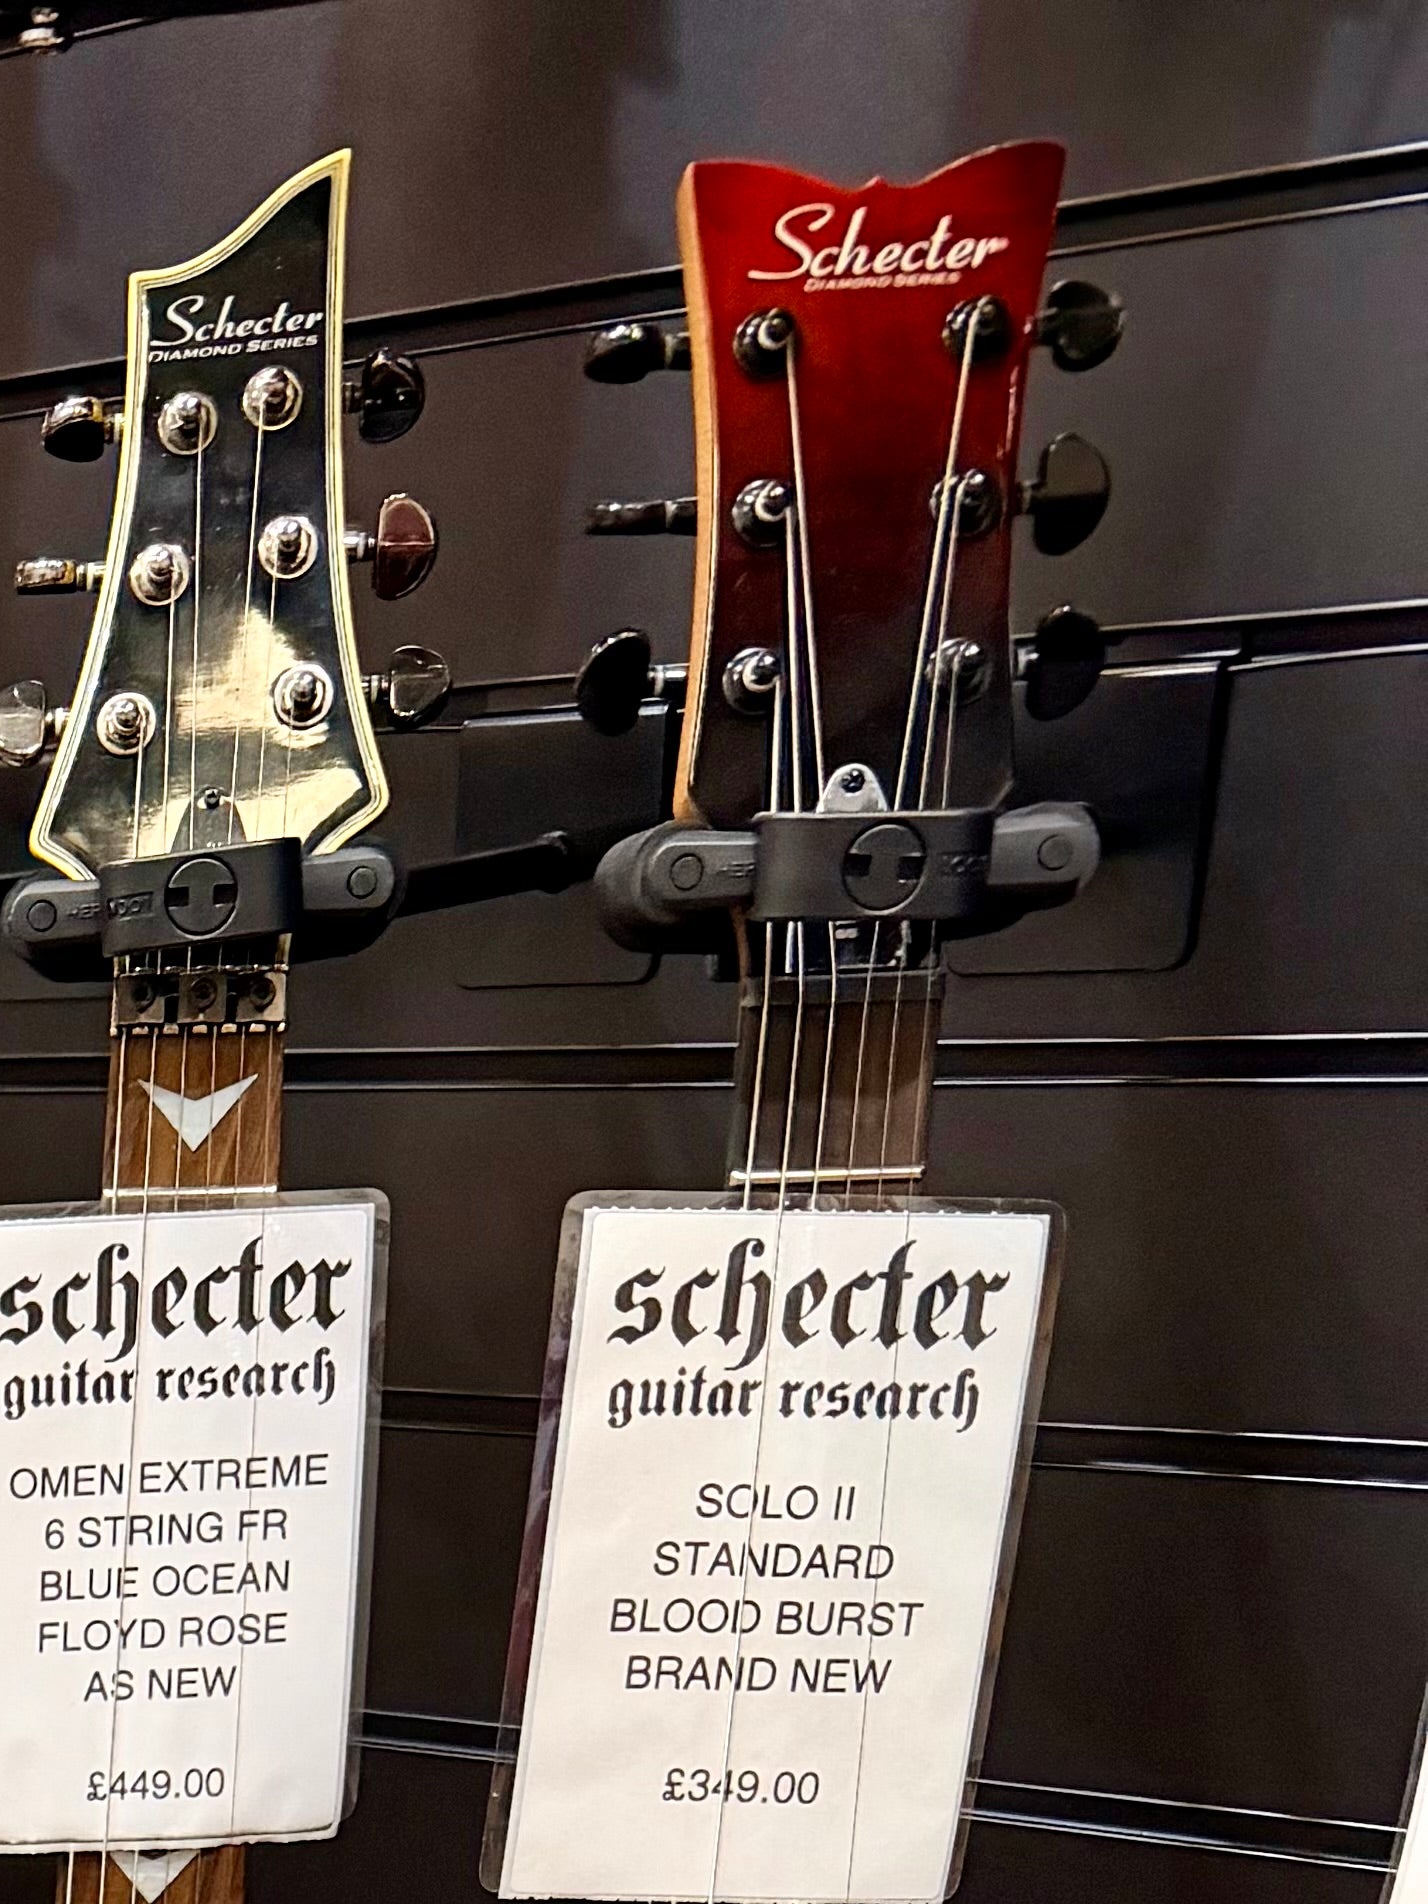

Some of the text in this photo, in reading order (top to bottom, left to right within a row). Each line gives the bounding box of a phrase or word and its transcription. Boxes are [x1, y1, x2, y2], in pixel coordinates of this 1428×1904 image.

[747, 202, 1010, 280] Schecter
[150, 294, 323, 347] Schecter
[148, 335, 318, 363] DIAMOND SERIES
[606, 1237, 1011, 1371] schecter
[3, 1347, 337, 1420] guitar research
[608, 1367, 980, 1432] guitar research
[9, 1454, 329, 1501] OMEN EXTREME
[695, 1484, 857, 1522] SOLO II
[45, 1510, 287, 1550] 6 STRING FR
[653, 1541, 895, 1580] STANDARD
[39, 1560, 291, 1603] BLUE OCEAN
[38, 1613, 288, 1655] FLOYD ROSE
[609, 1598, 924, 1638] BLOOD BURST
[84, 1666, 236, 1702] AS NEW
[625, 1656, 892, 1694] BRAND NEW
[87, 1767, 226, 1802] £449.00
[661, 1768, 820, 1806] £349.00
